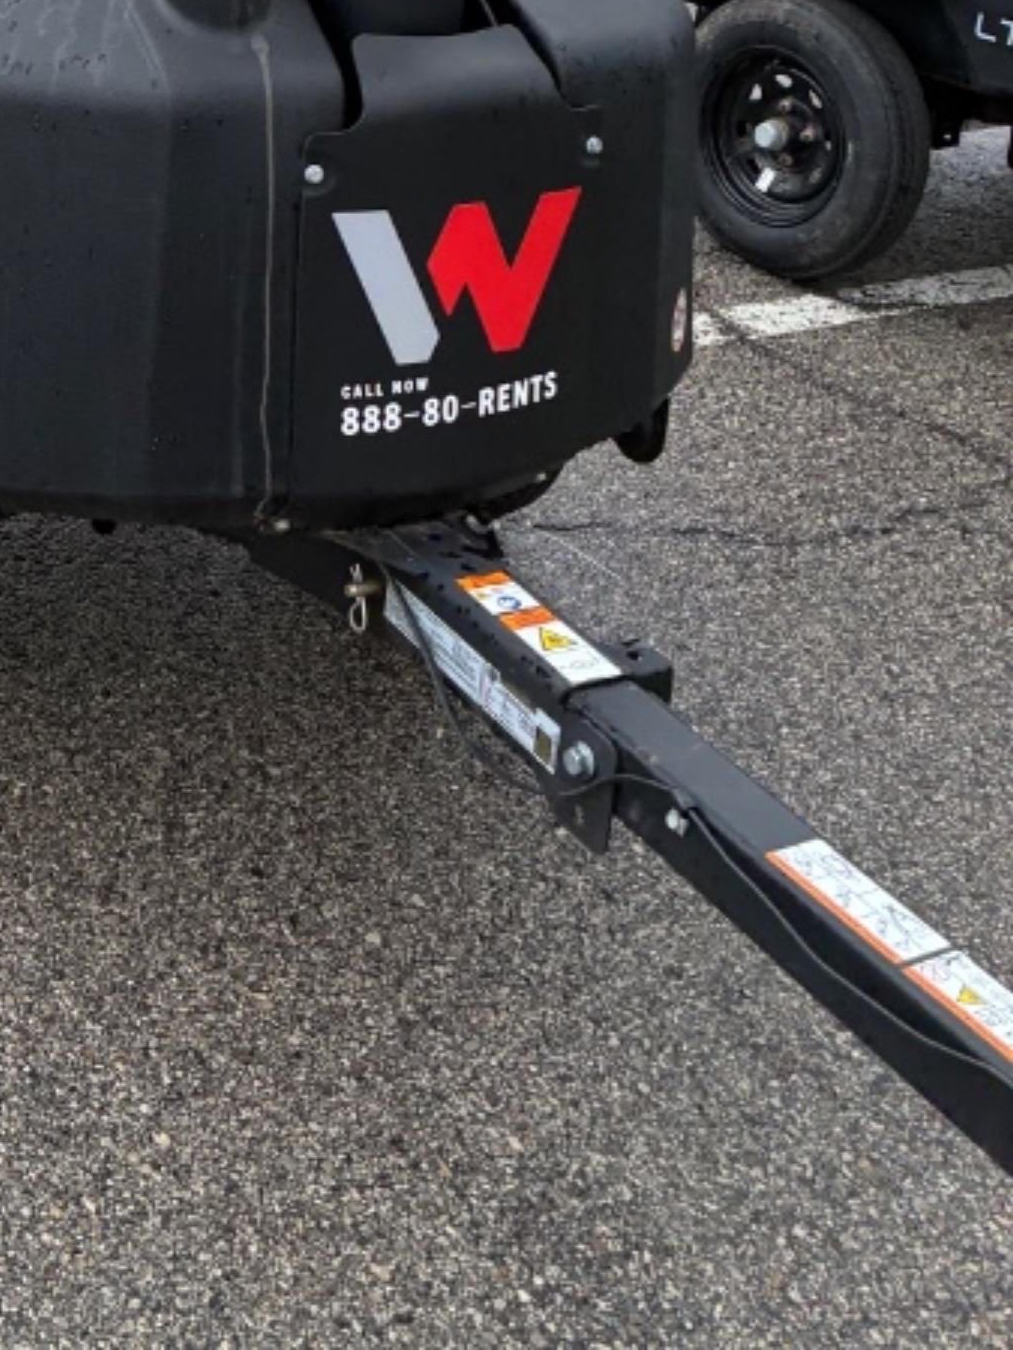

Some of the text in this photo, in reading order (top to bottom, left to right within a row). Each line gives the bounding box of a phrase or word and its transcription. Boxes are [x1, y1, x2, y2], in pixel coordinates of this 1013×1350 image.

[339, 370, 558, 437] 888-80-RENTS
[340, 376, 430, 400] CALL NOW
